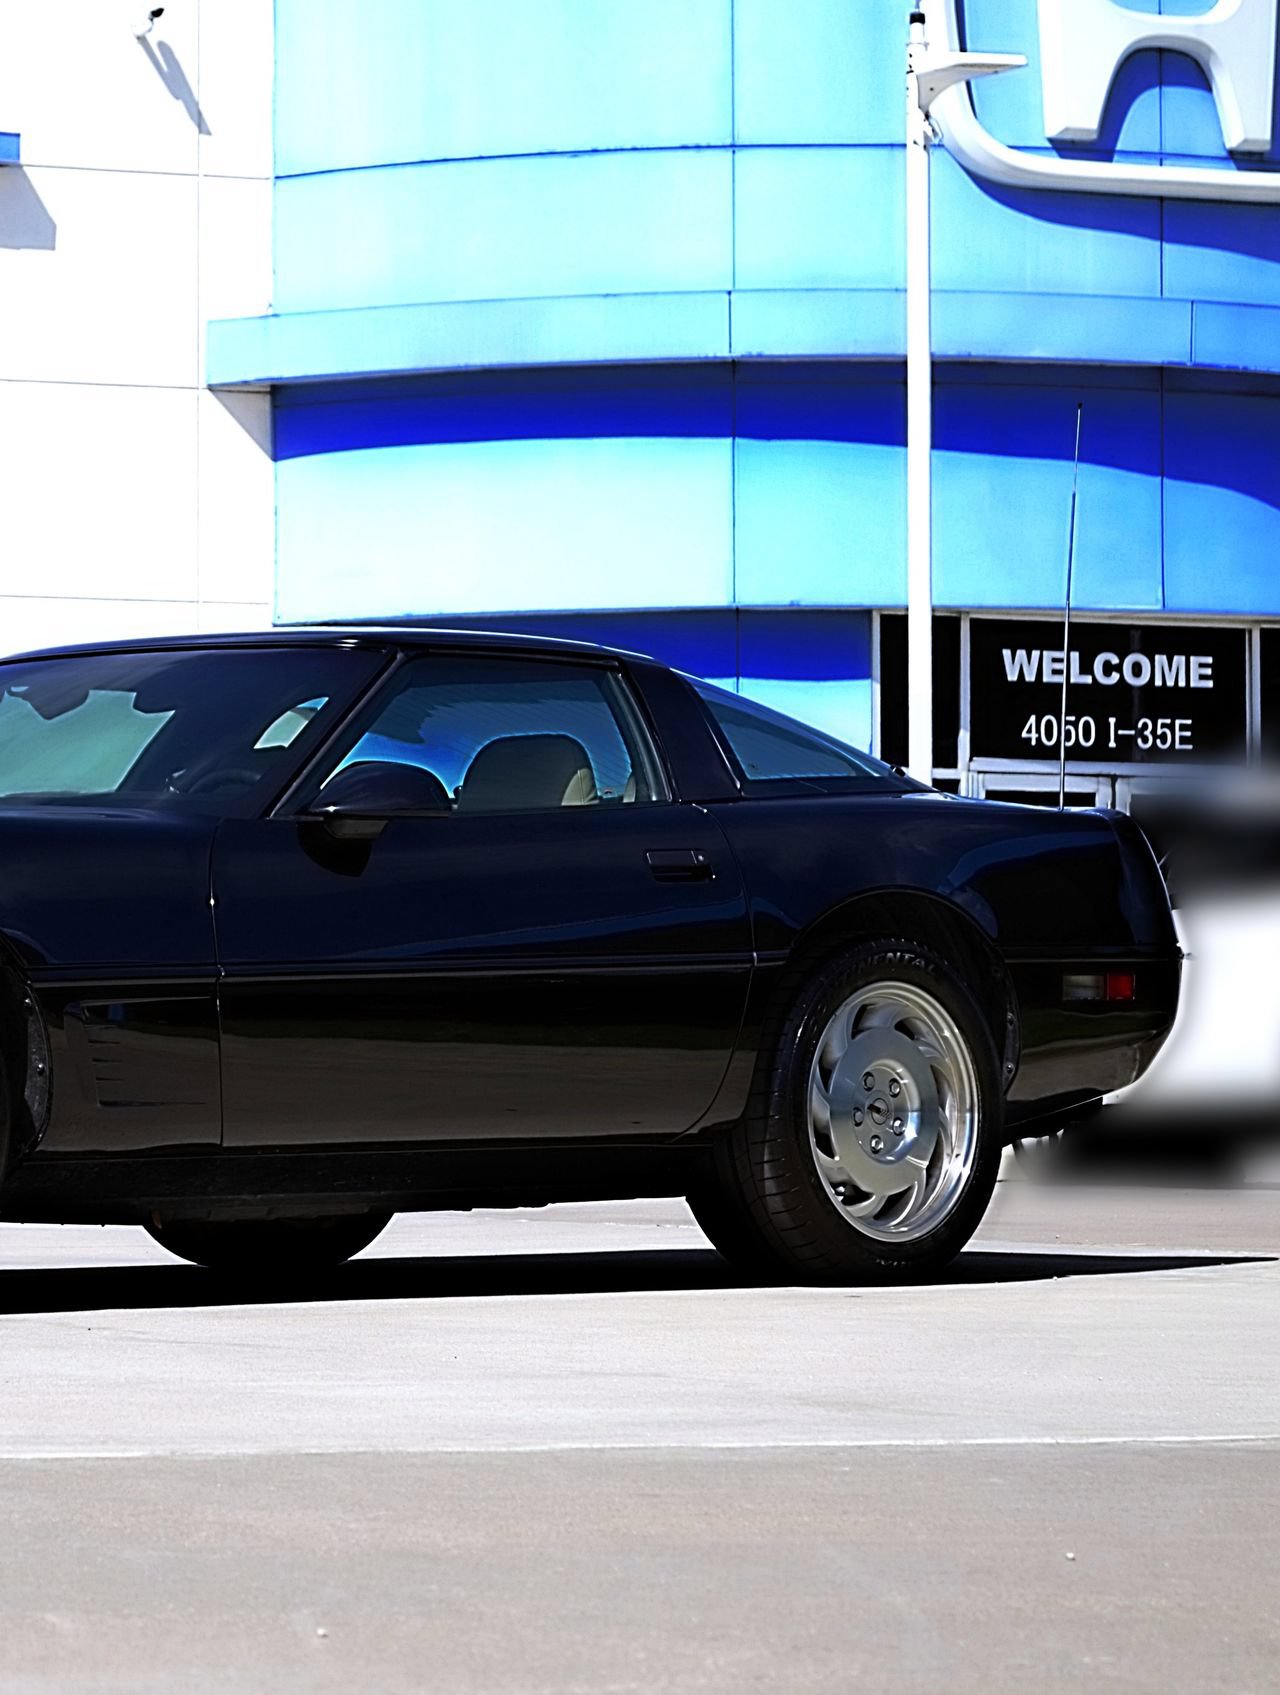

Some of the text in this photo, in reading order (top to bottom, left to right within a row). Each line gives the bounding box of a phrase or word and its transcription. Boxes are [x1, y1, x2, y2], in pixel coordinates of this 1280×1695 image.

[1002, 648, 1214, 688] WELCOME
[1021, 714, 1193, 750] 4050 I-35E
